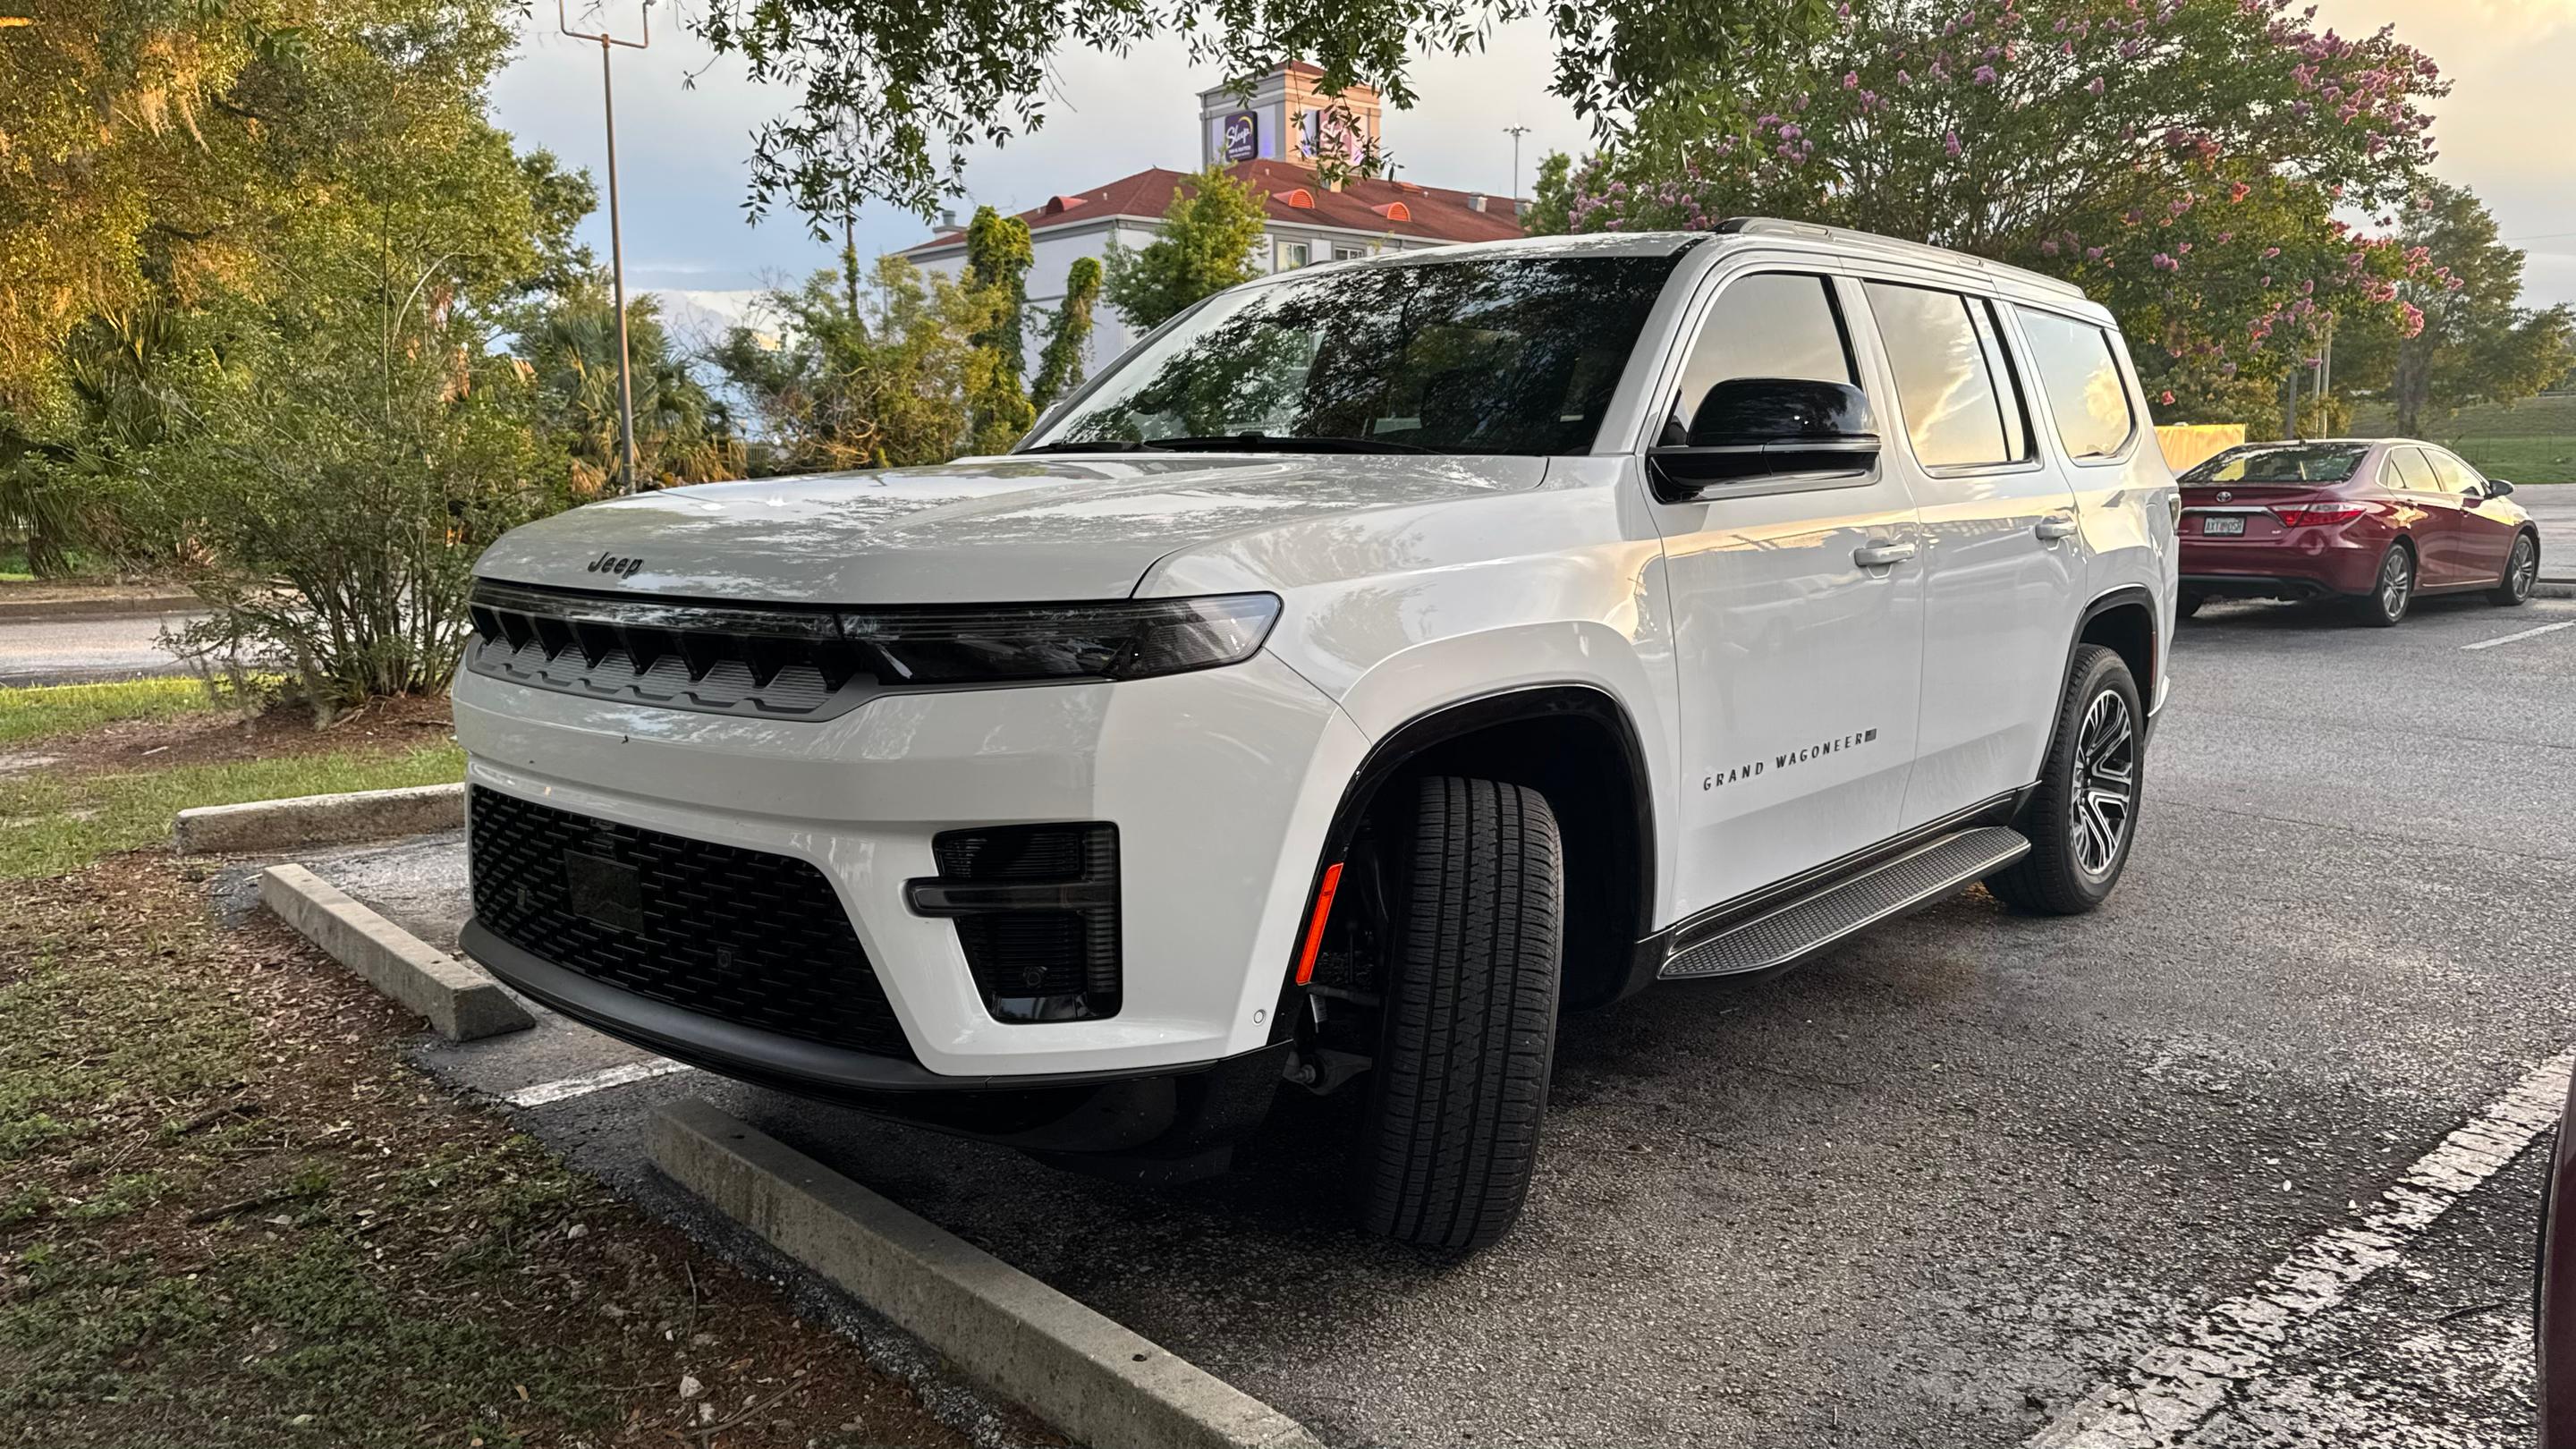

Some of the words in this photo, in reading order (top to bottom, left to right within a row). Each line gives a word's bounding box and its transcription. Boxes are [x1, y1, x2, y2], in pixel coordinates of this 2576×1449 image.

[1225, 124, 1250, 148] Sleep
[587, 551, 643, 580] Jeep
[1703, 762, 1764, 792] GRAND
[1775, 733, 1862, 769] WAGONEER
